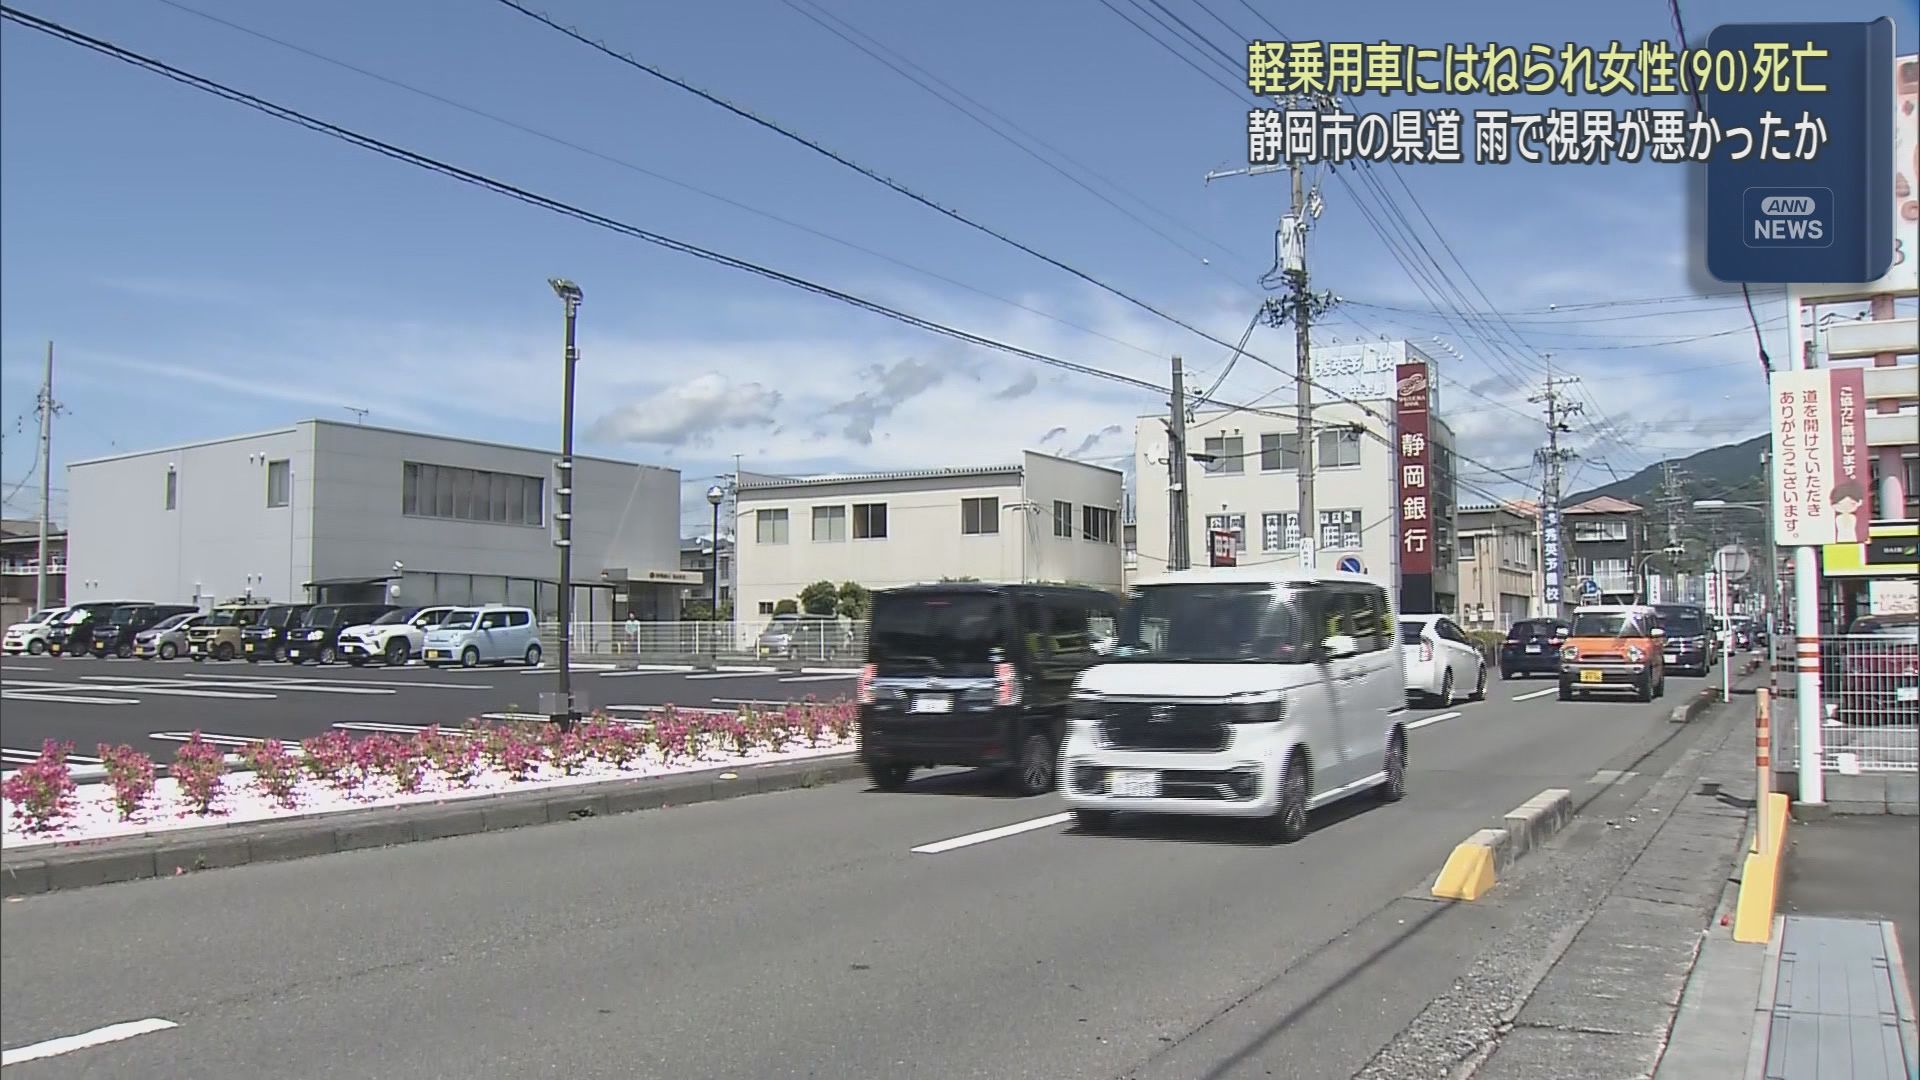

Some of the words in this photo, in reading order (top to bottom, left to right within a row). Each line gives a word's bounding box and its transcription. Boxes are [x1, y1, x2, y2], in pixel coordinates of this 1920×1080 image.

[1401, 433, 1428, 552] 静岡銀行
[1779, 391, 1799, 538] ありがとうございます。
[1802, 390, 1821, 517] 道を開けていただき
